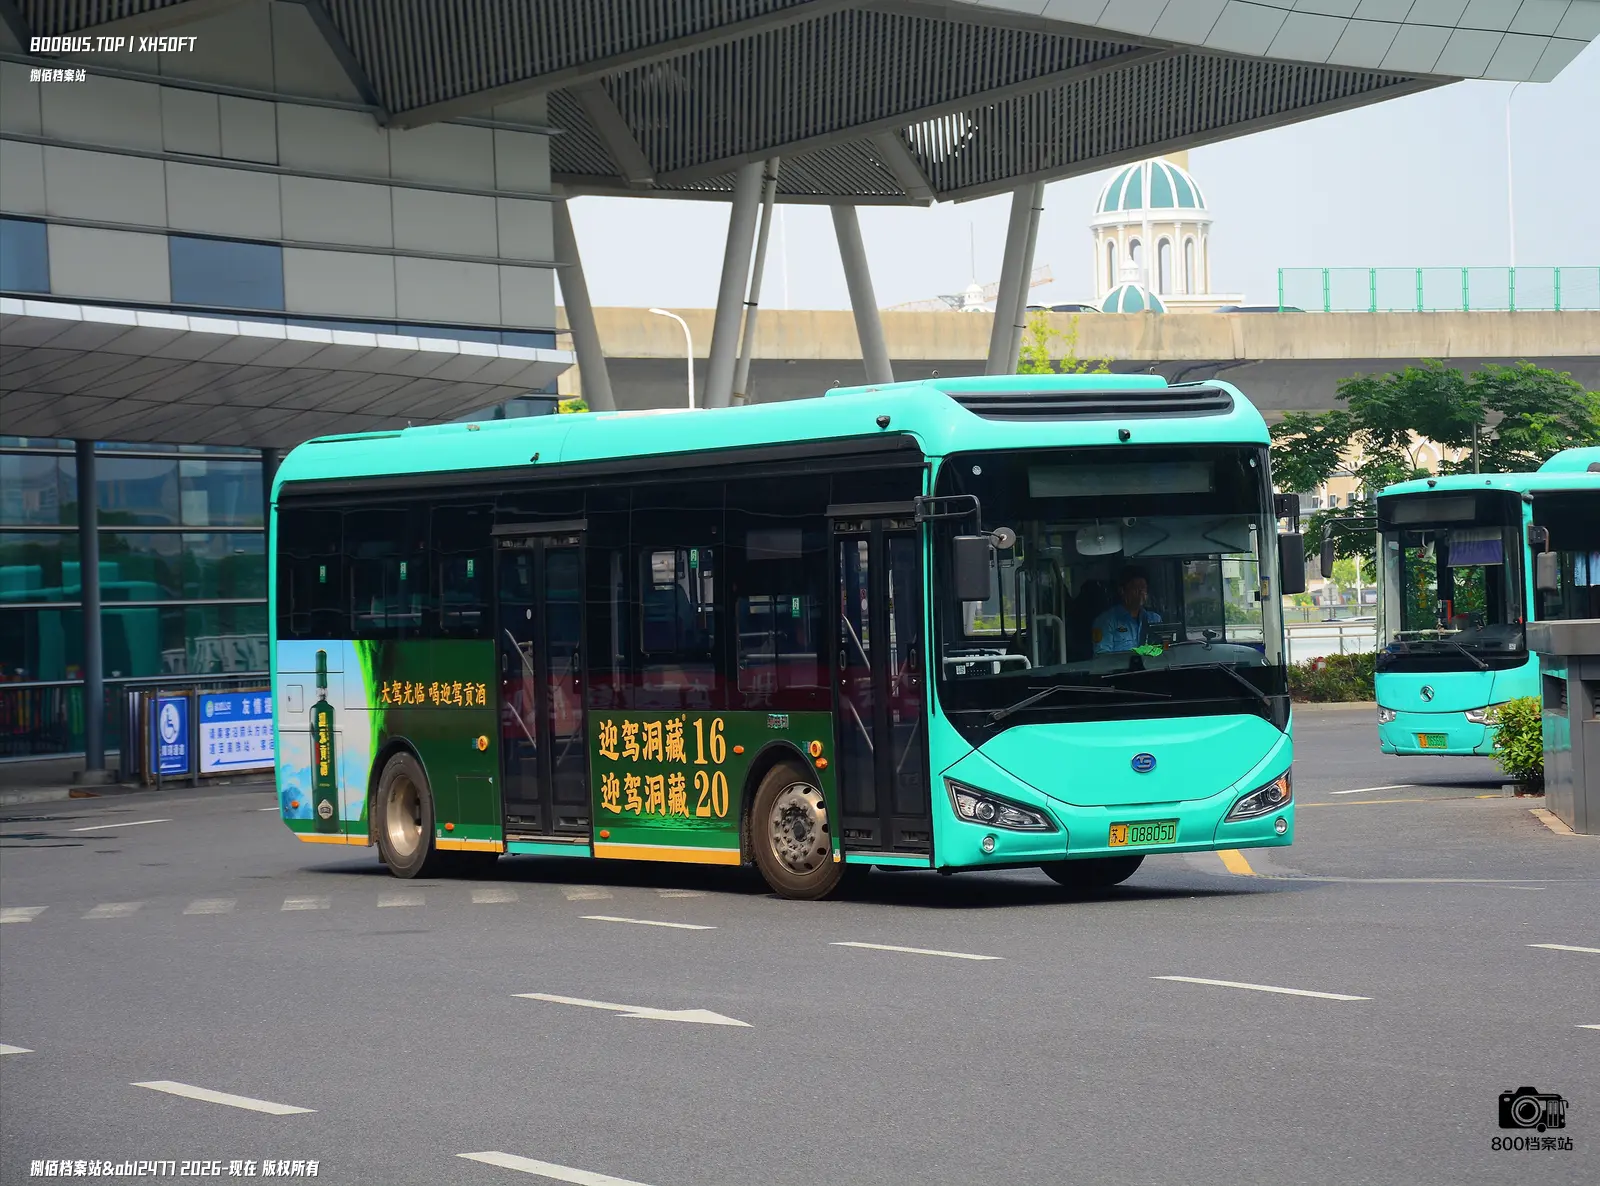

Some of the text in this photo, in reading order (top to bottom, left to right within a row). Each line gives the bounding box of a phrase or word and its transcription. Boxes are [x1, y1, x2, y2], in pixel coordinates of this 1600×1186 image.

[381, 680, 487, 707] 大驾光临 喝迎驾贡酒
[160, 744, 185, 757] 障碍通道
[598, 717, 727, 764] 迎驾洞藏 16
[601, 770, 729, 818] 迎驾洞藏 20
